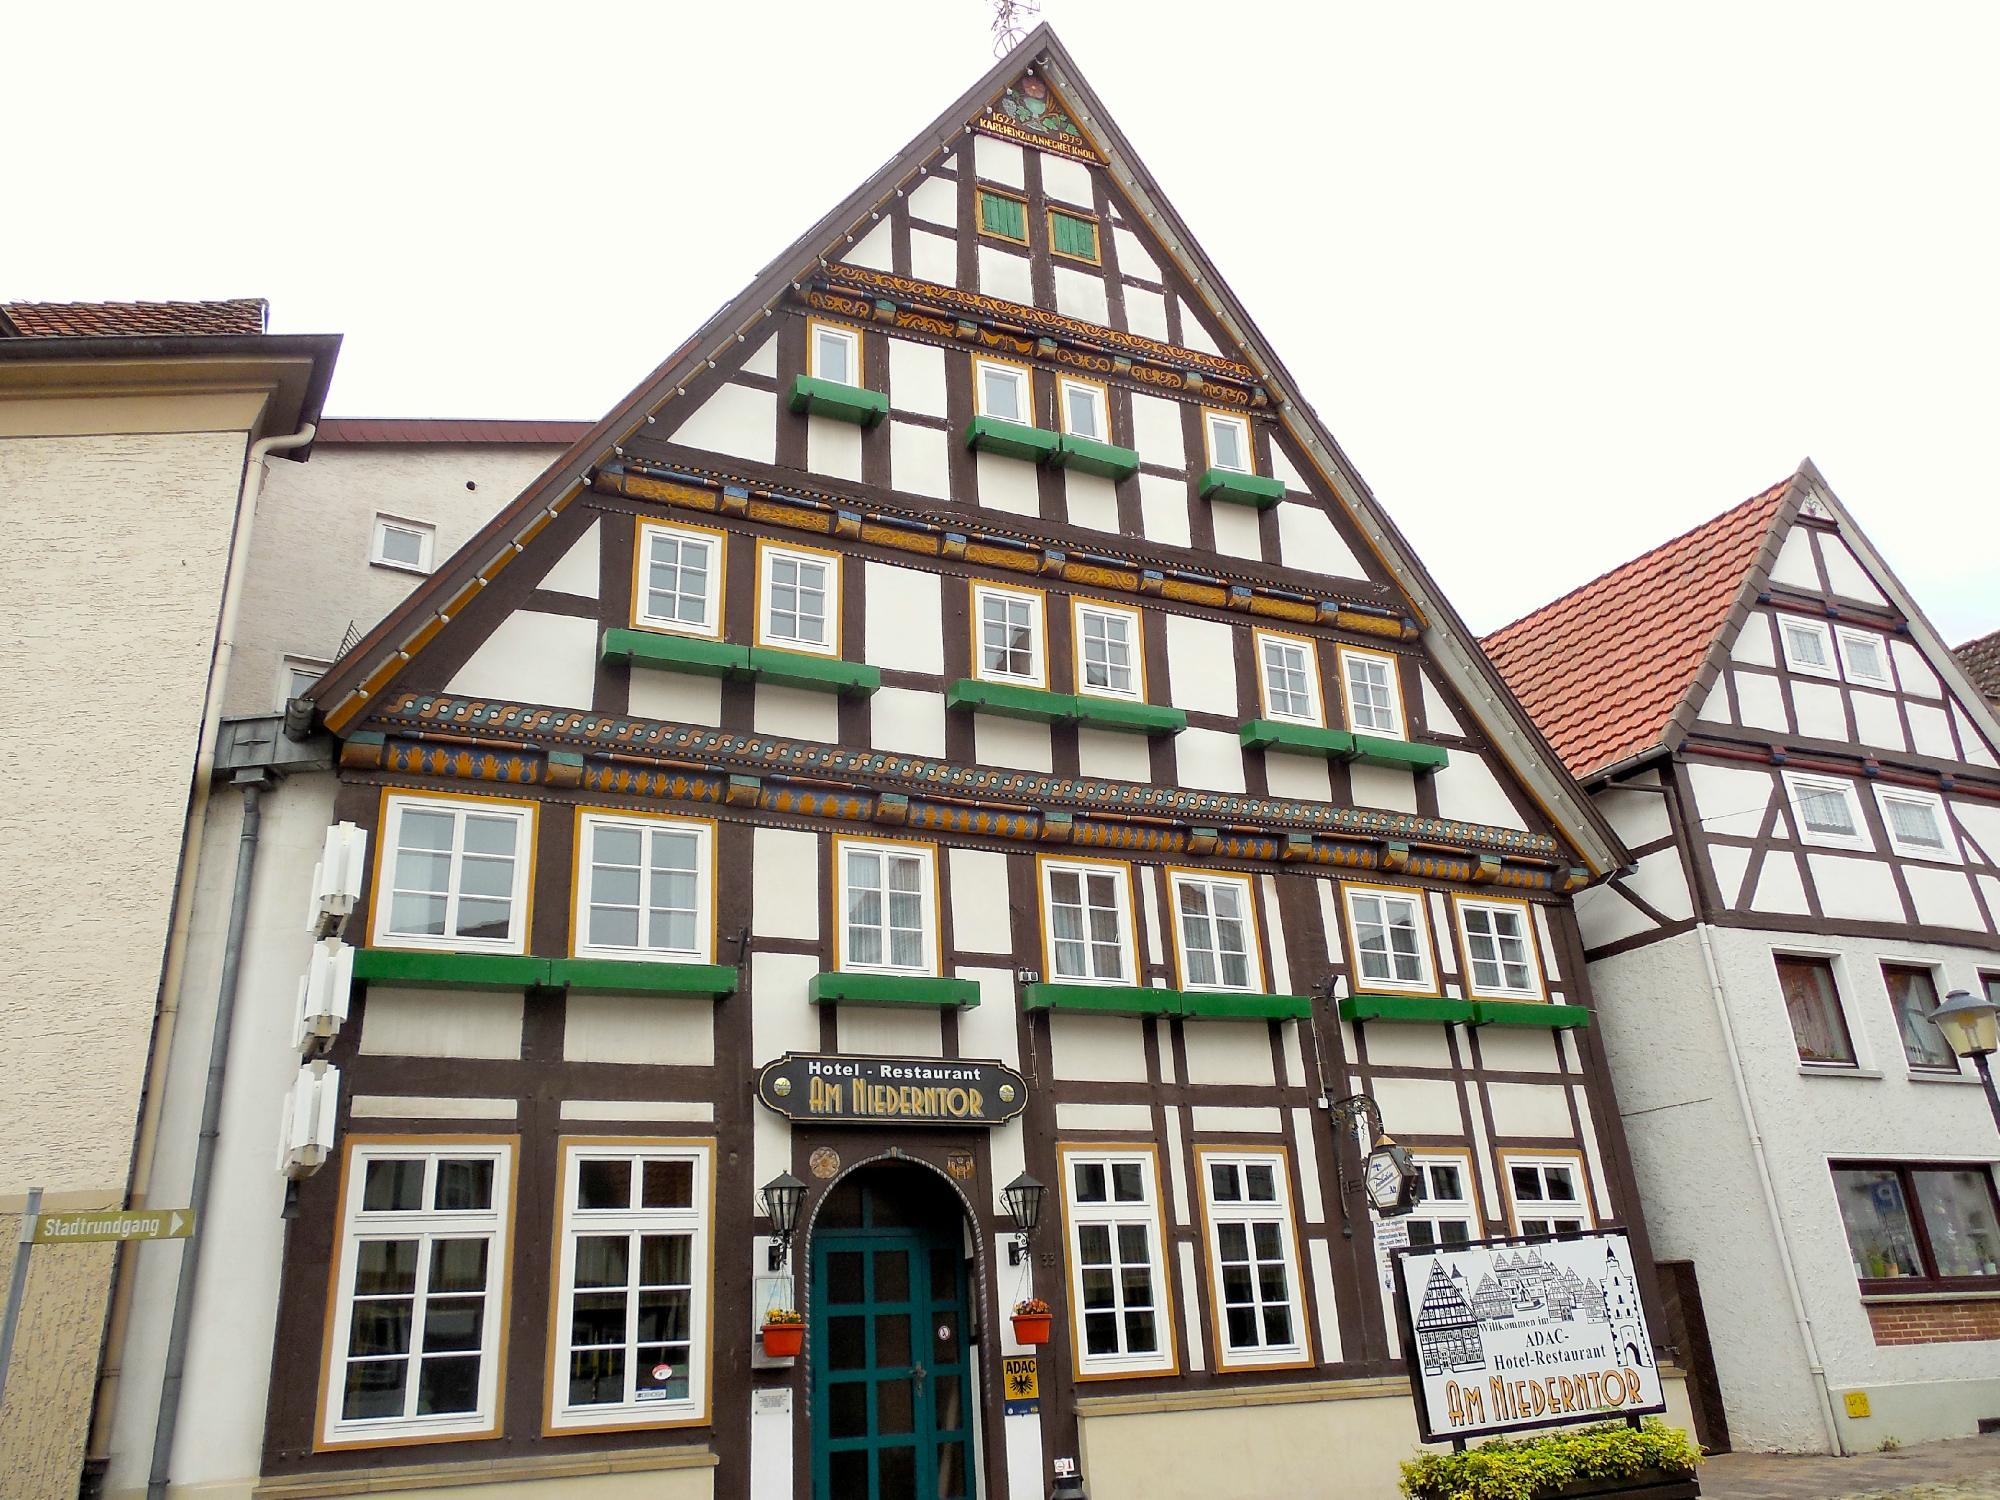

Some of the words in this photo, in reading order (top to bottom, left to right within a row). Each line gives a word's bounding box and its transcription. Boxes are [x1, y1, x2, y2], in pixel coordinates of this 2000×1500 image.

[1072, 145, 1097, 160] KNOLL
[808, 1061, 860, 1076] Hotel
[880, 1064, 982, 1081] Restaurant
[44, 1216, 160, 1237] Stadtrundgang
[1479, 1317, 1535, 1333] Willkommen
[1537, 1315, 1550, 1326] im
[1525, 1328, 1569, 1348] ADAC-
[1006, 1360, 1036, 1375] ADAC
[1493, 1344, 1607, 1371] Hotel-Restaurant
